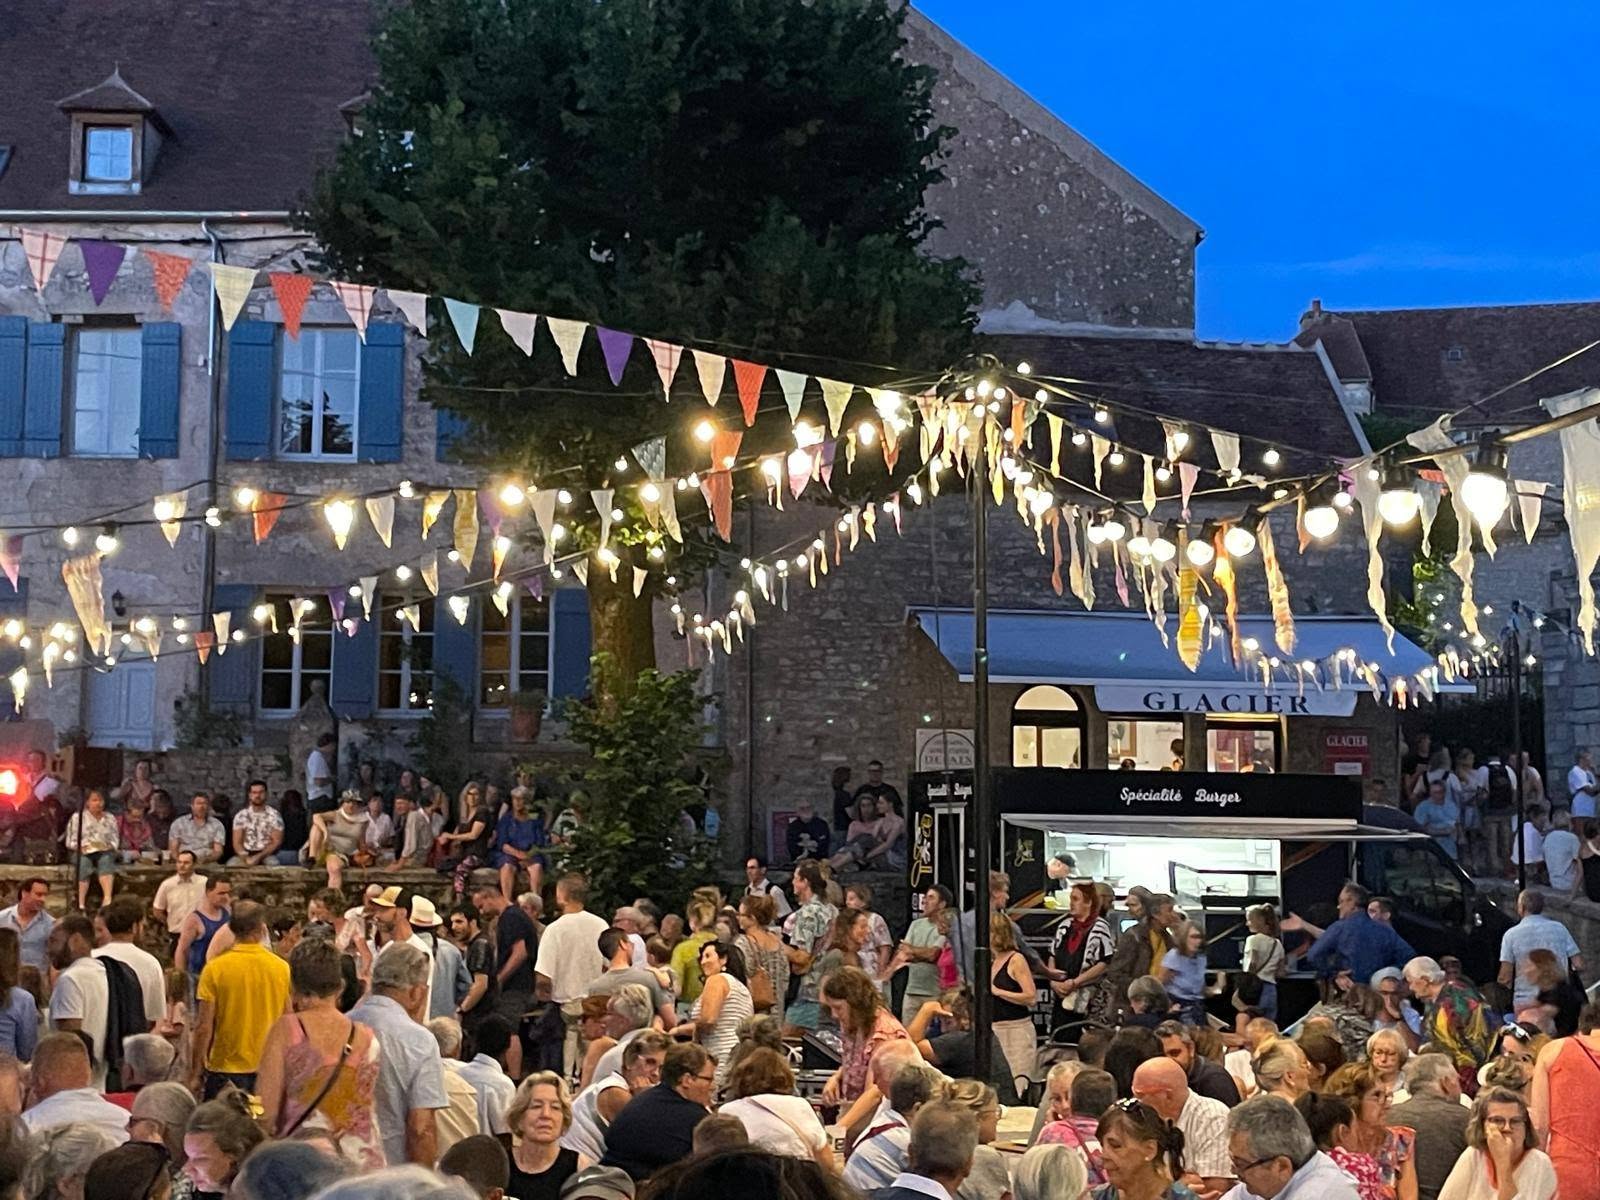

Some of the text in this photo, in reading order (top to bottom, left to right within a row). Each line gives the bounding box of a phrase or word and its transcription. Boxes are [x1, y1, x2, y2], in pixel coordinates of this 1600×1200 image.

[1143, 691, 1311, 714] GLACIER
[1326, 735, 1368, 747] GLACIER
[1120, 787, 1242, 807] Spécialité Burger
